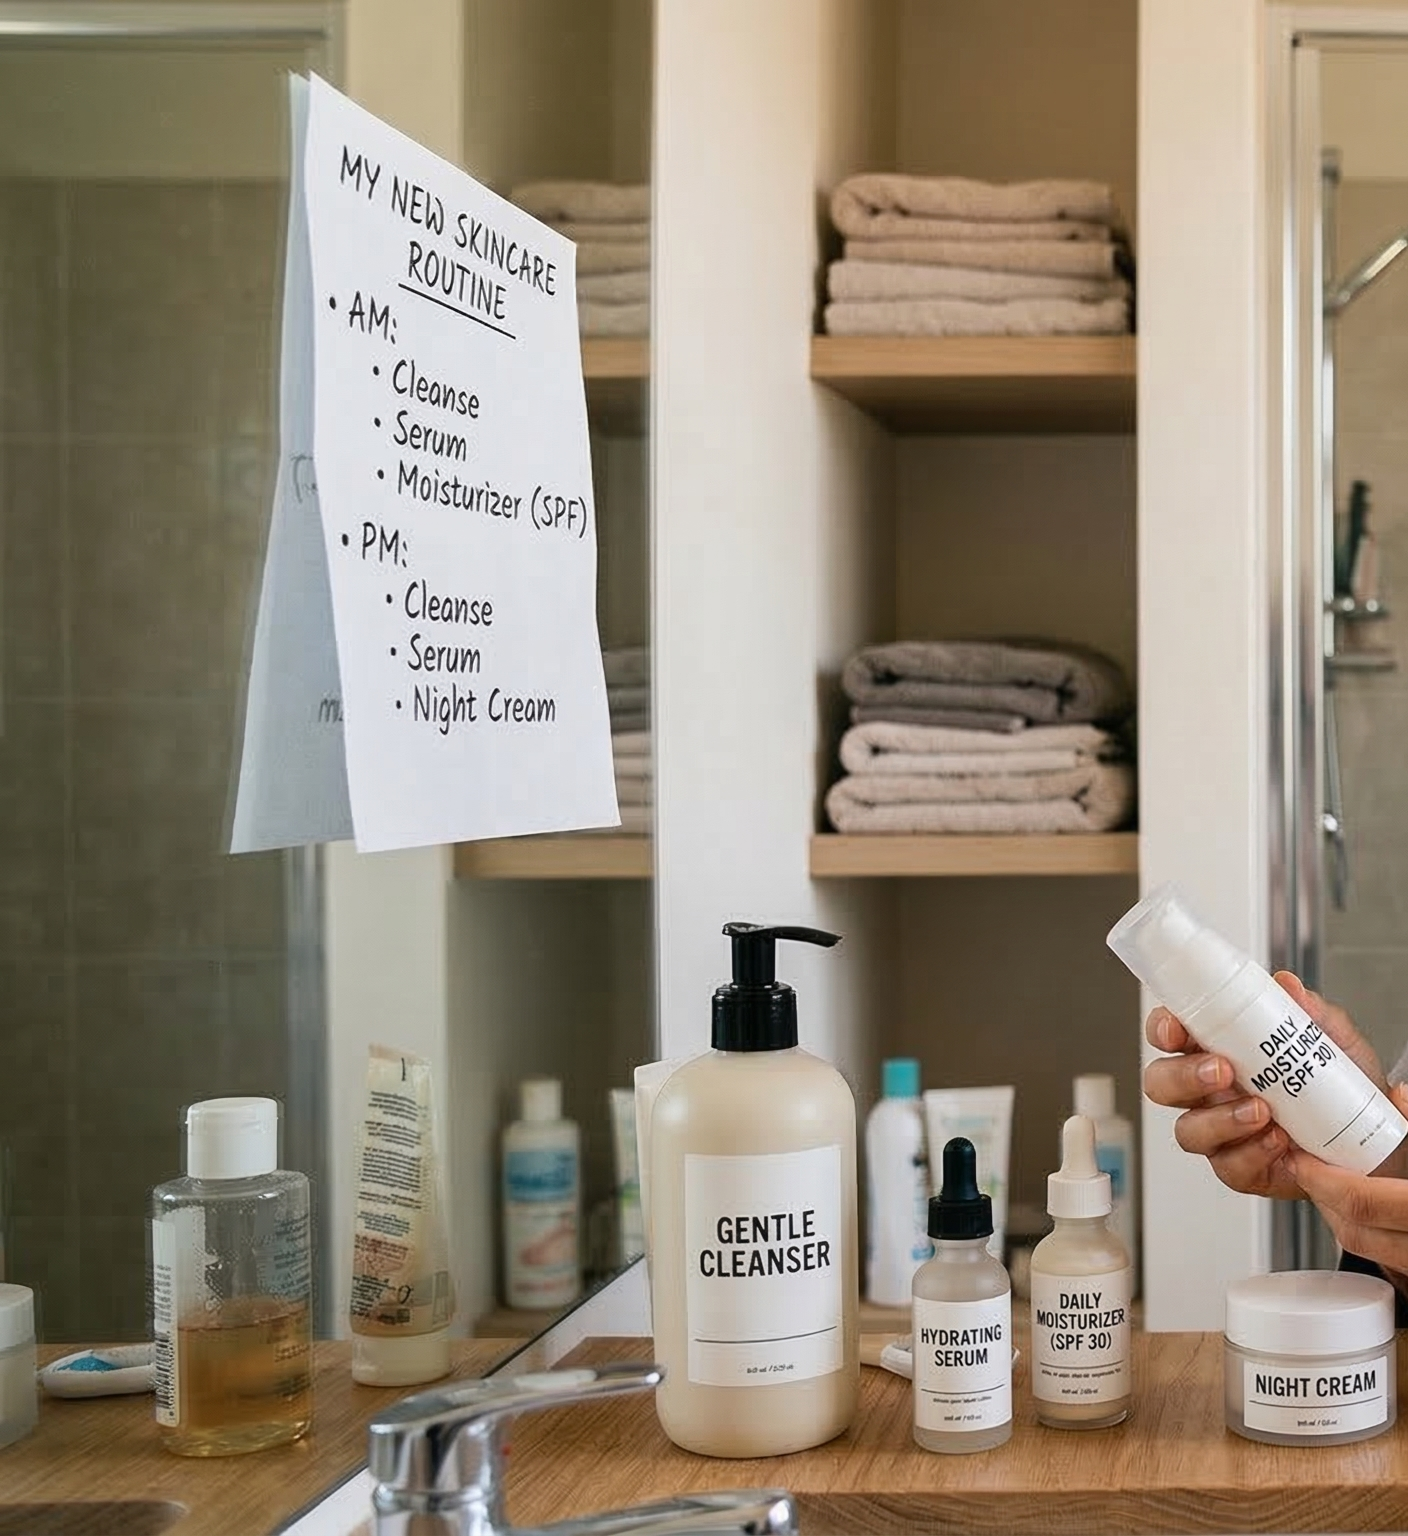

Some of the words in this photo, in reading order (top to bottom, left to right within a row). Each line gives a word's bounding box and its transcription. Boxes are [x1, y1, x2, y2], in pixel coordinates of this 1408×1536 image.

[340, 146, 381, 199] MY
[391, 176, 444, 236] NEW
[454, 213, 557, 296] SKINCARE
[408, 241, 507, 320] ROUTINE
[349, 291, 397, 344] AM:
[393, 359, 480, 419] Cleanse
[394, 410, 467, 462] Serum
[398, 460, 521, 520] Moisturizer
[531, 485, 587, 539] (SPF)
[362, 521, 408, 568] PM:
[404, 578, 493, 627] Cleanse
[407, 633, 481, 674] Serum
[414, 684, 477, 736] Night
[488, 687, 556, 722] Cream
[1259, 1015, 1298, 1059] DAILY
[1282, 1060, 1315, 1098] (SPF
[1312, 1041, 1337, 1068] 30)
[716, 1209, 816, 1245] GENTLE
[699, 1240, 831, 1278] CLEANSER
[1036, 1308, 1126, 1330] MOISTURIZER
[1059, 1292, 1102, 1310] DAILY
[920, 1324, 1002, 1347] HYDRATING
[934, 1347, 988, 1367] SERUM
[1050, 1333, 1084, 1352] (SPF
[1088, 1332, 1112, 1351] 30)
[1255, 1373, 1311, 1398] NIGHT
[1315, 1369, 1377, 1398] CREAM
